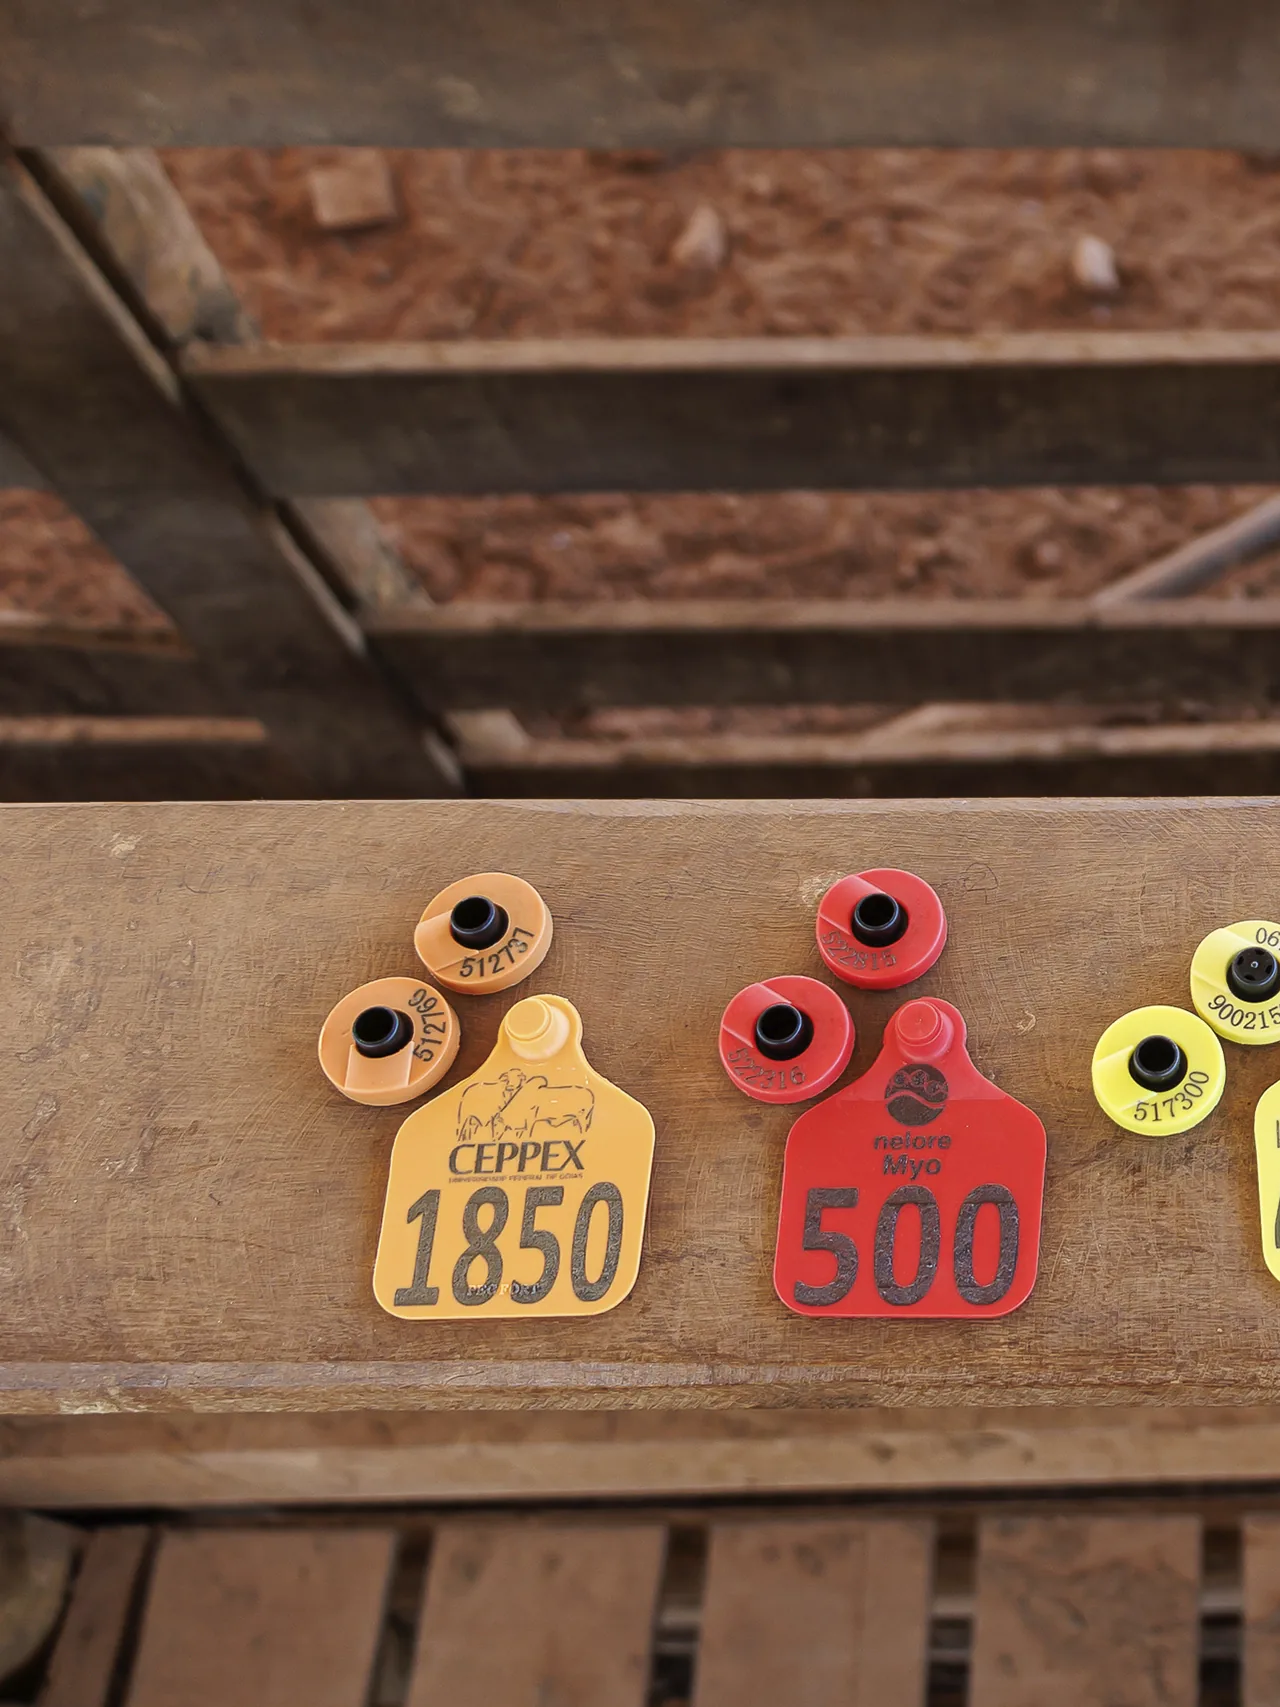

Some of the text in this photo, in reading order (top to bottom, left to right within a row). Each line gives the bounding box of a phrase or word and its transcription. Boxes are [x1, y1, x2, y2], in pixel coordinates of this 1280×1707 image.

[459, 926, 535, 978] 512737
[821, 930, 897, 970] 522815
[727, 1047, 806, 1089] 522316
[1133, 1070, 1210, 1122] 517300
[448, 1139, 586, 1175] CEPPEX
[873, 1131, 952, 1150] nelore
[882, 1154, 942, 1180] Myo
[393, 1181, 625, 1307] 1850
[793, 1183, 1020, 1307] 500
